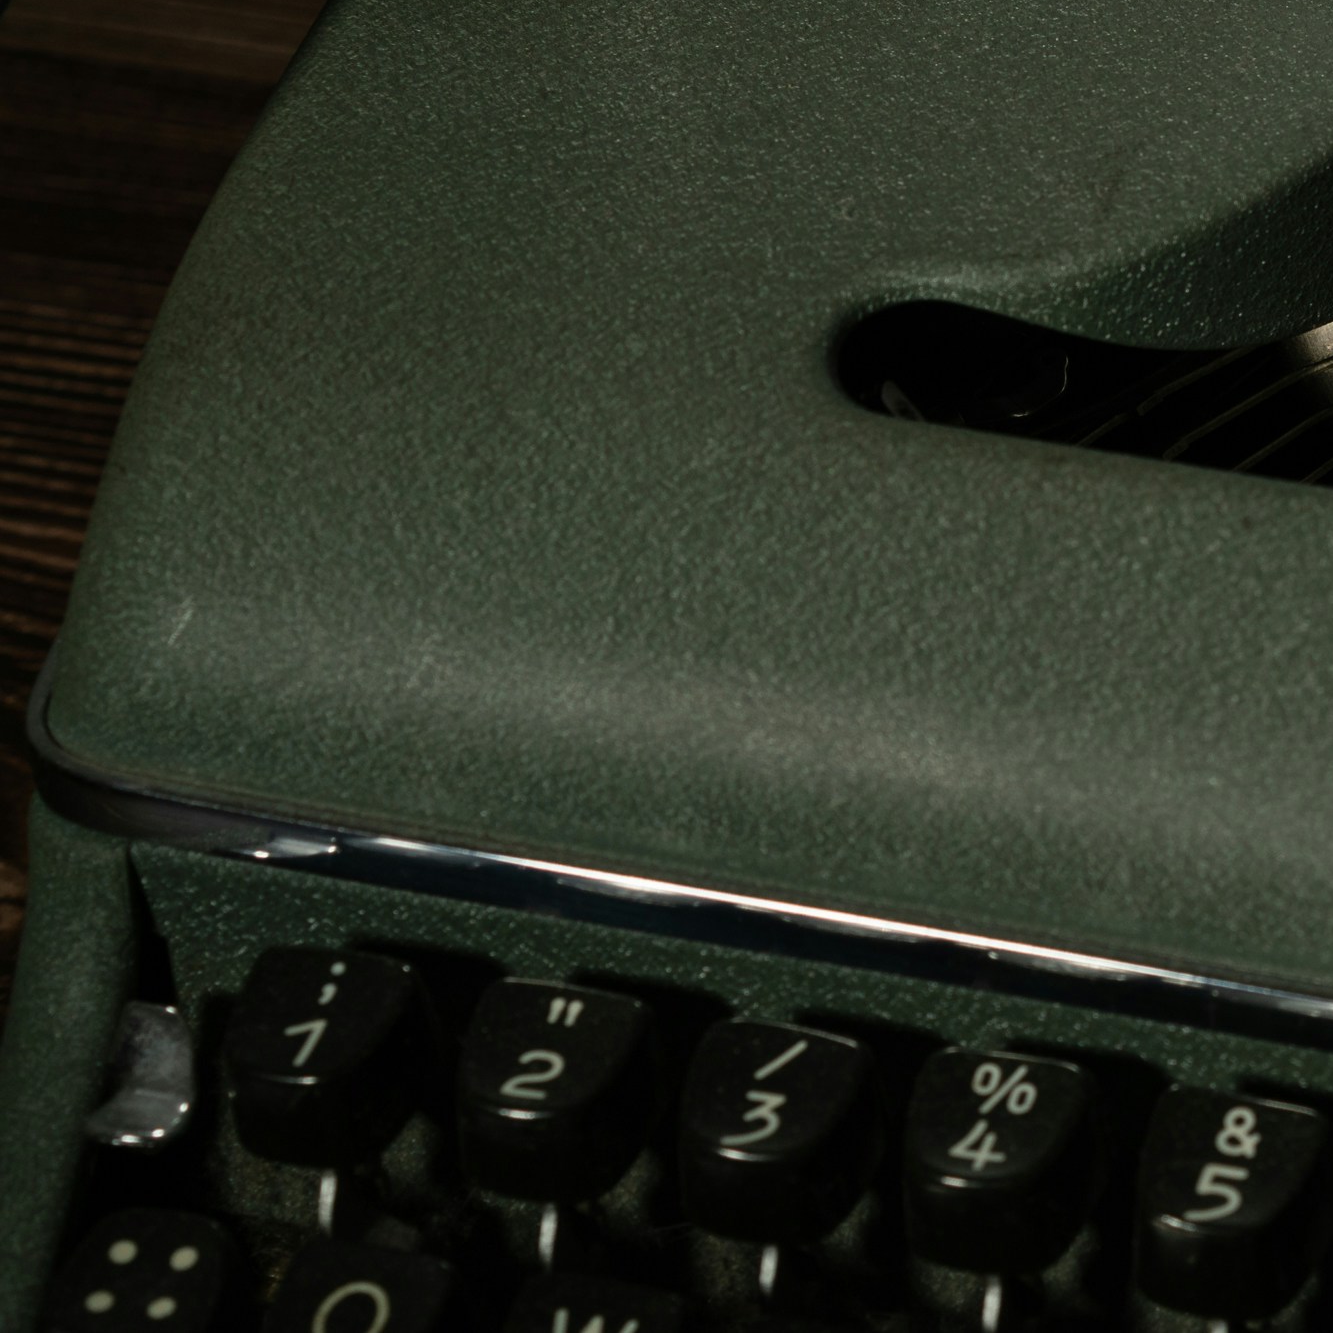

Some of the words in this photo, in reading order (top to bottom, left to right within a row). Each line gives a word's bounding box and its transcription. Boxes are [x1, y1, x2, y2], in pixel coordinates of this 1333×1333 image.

[284, 1018, 328, 1067] 1
[499, 1048, 566, 1101] 2
[971, 1062, 1038, 1115] %
[720, 1090, 787, 1147] 3
[1215, 1106, 1261, 1159] &
[948, 1119, 1006, 1172] 4
[1185, 1163, 1249, 1222] 5
